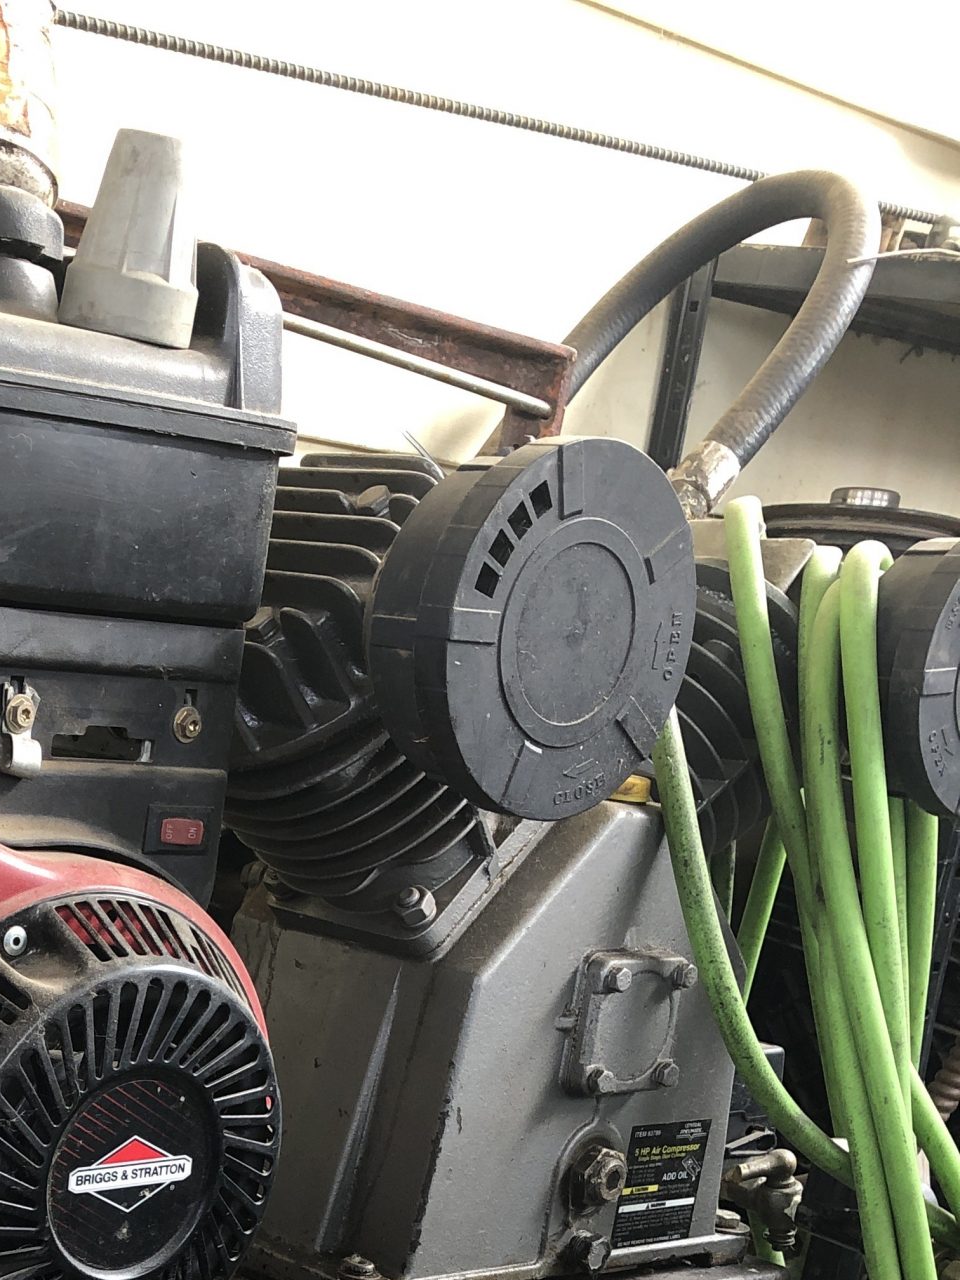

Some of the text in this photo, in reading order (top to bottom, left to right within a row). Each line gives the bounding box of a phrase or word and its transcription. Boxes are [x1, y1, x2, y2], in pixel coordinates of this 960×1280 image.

[662, 610, 683, 681] OPEN
[552, 772, 606, 806] CLOSE
[165, 823, 174, 839] OFF
[188, 827, 197, 839] ON
[634, 1143, 701, 1157] 5 HP Air Compressor
[75, 1163, 185, 1186] BRIGGS & STRATTON
[662, 1172, 676, 1181] ADD
[677, 1170, 689, 1179] OIL
